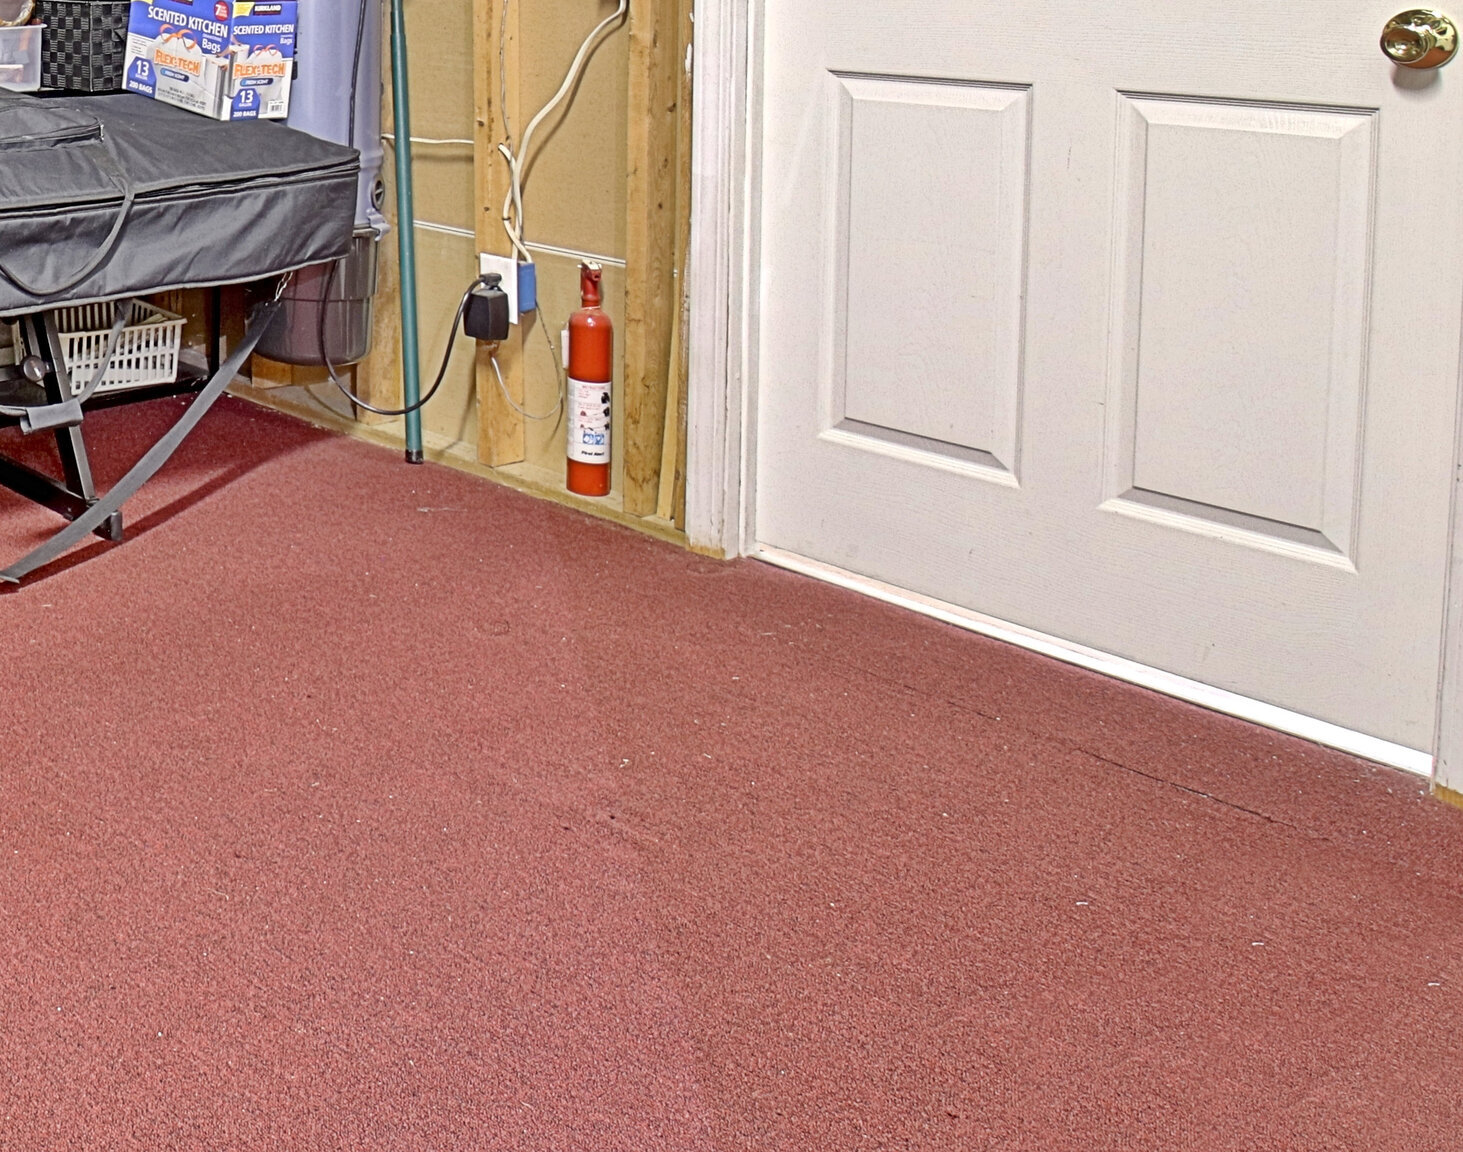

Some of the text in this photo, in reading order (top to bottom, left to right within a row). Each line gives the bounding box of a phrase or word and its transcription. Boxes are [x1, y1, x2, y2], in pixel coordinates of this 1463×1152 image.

[148, 6, 187, 26] SCENTED
[188, 16, 228, 38] KITCHEN
[233, 24, 294, 34] SCENTED KITCHEN
[202, 38, 221, 54] Bags
[136, 60, 149, 75] 13
[138, 83, 152, 94] BAGS
[240, 90, 253, 102] 13
